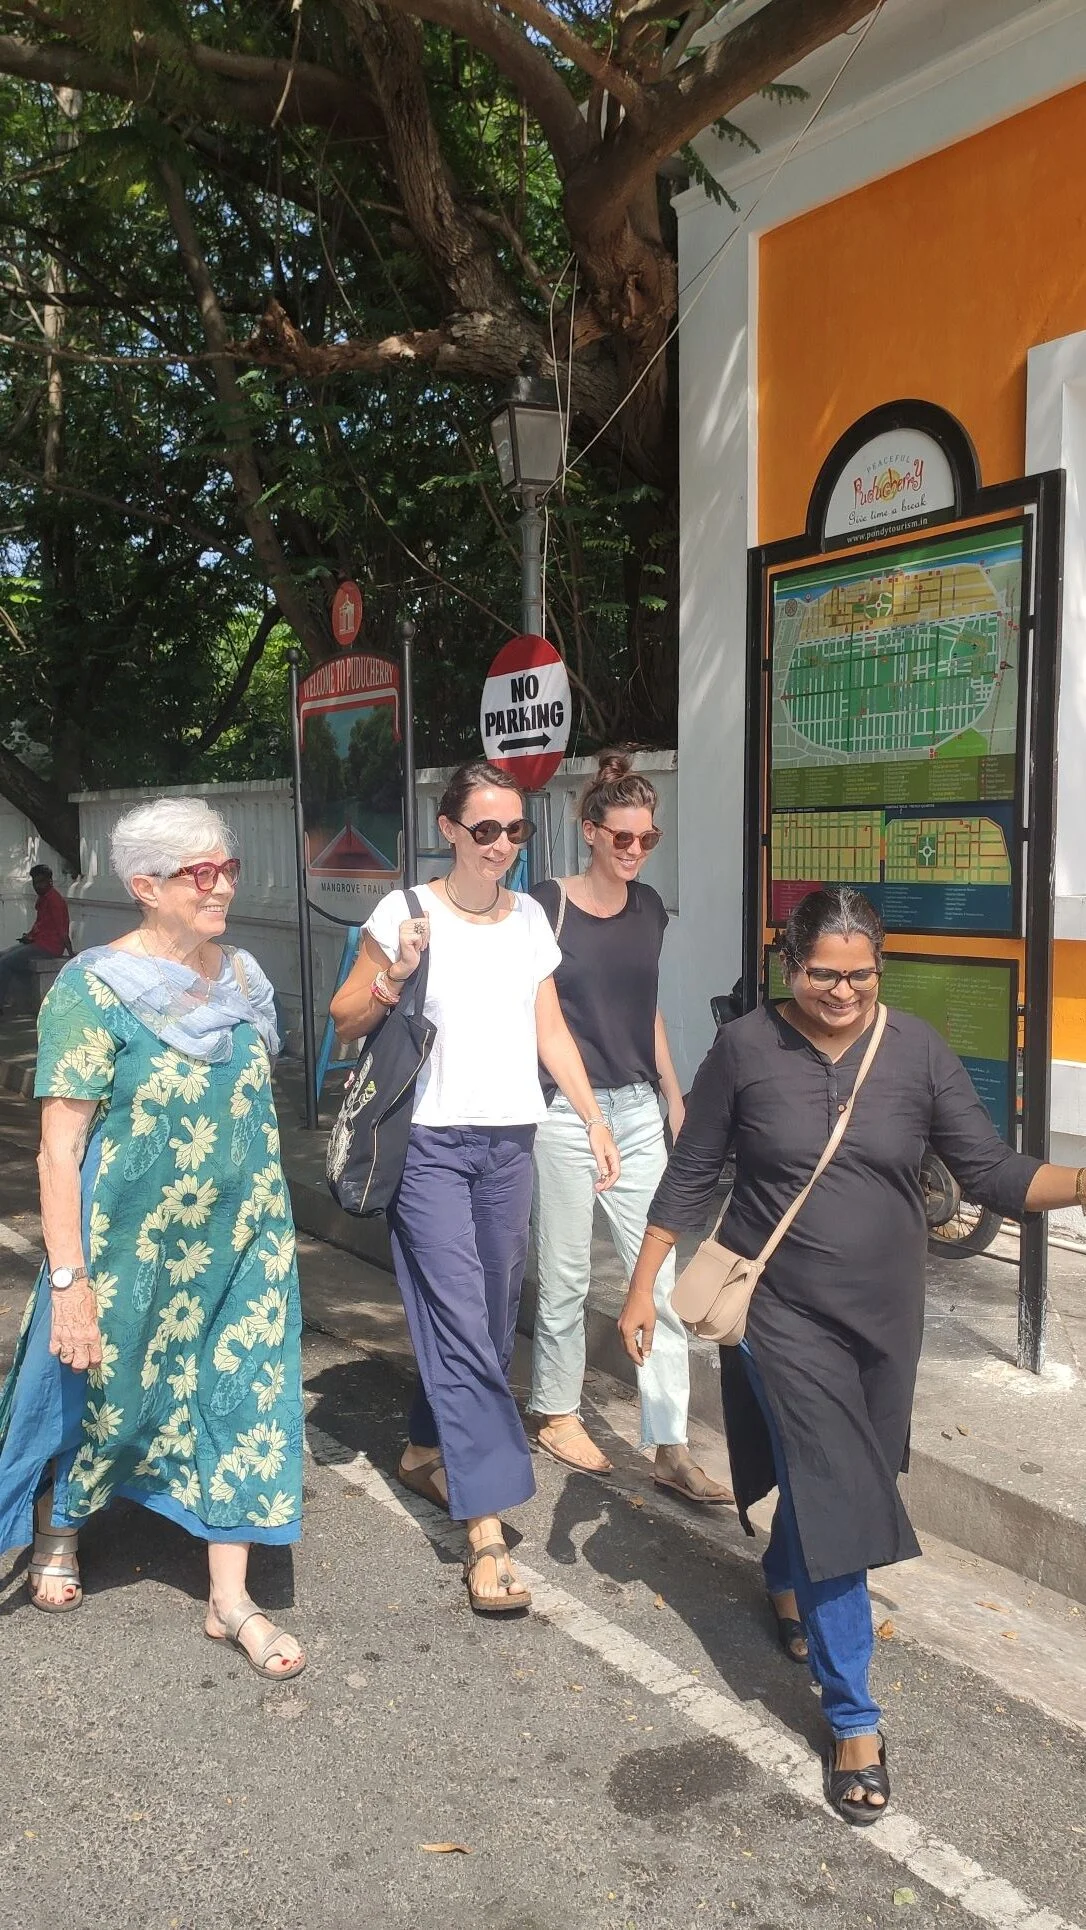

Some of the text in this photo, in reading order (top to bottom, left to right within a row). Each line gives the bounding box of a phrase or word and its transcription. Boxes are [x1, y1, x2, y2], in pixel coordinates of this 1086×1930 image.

[866, 454, 910, 472] PEACEFUL
[848, 511, 867, 525] Give
[870, 510, 887, 520] time
[901, 493, 926, 511] break
[303, 657, 394, 697] WELCOME TO PUDUCHERRY
[510, 675, 539, 702] NO
[484, 700, 564, 737] PARKING
[321, 882, 385, 895] MANGROVE TRAIL
